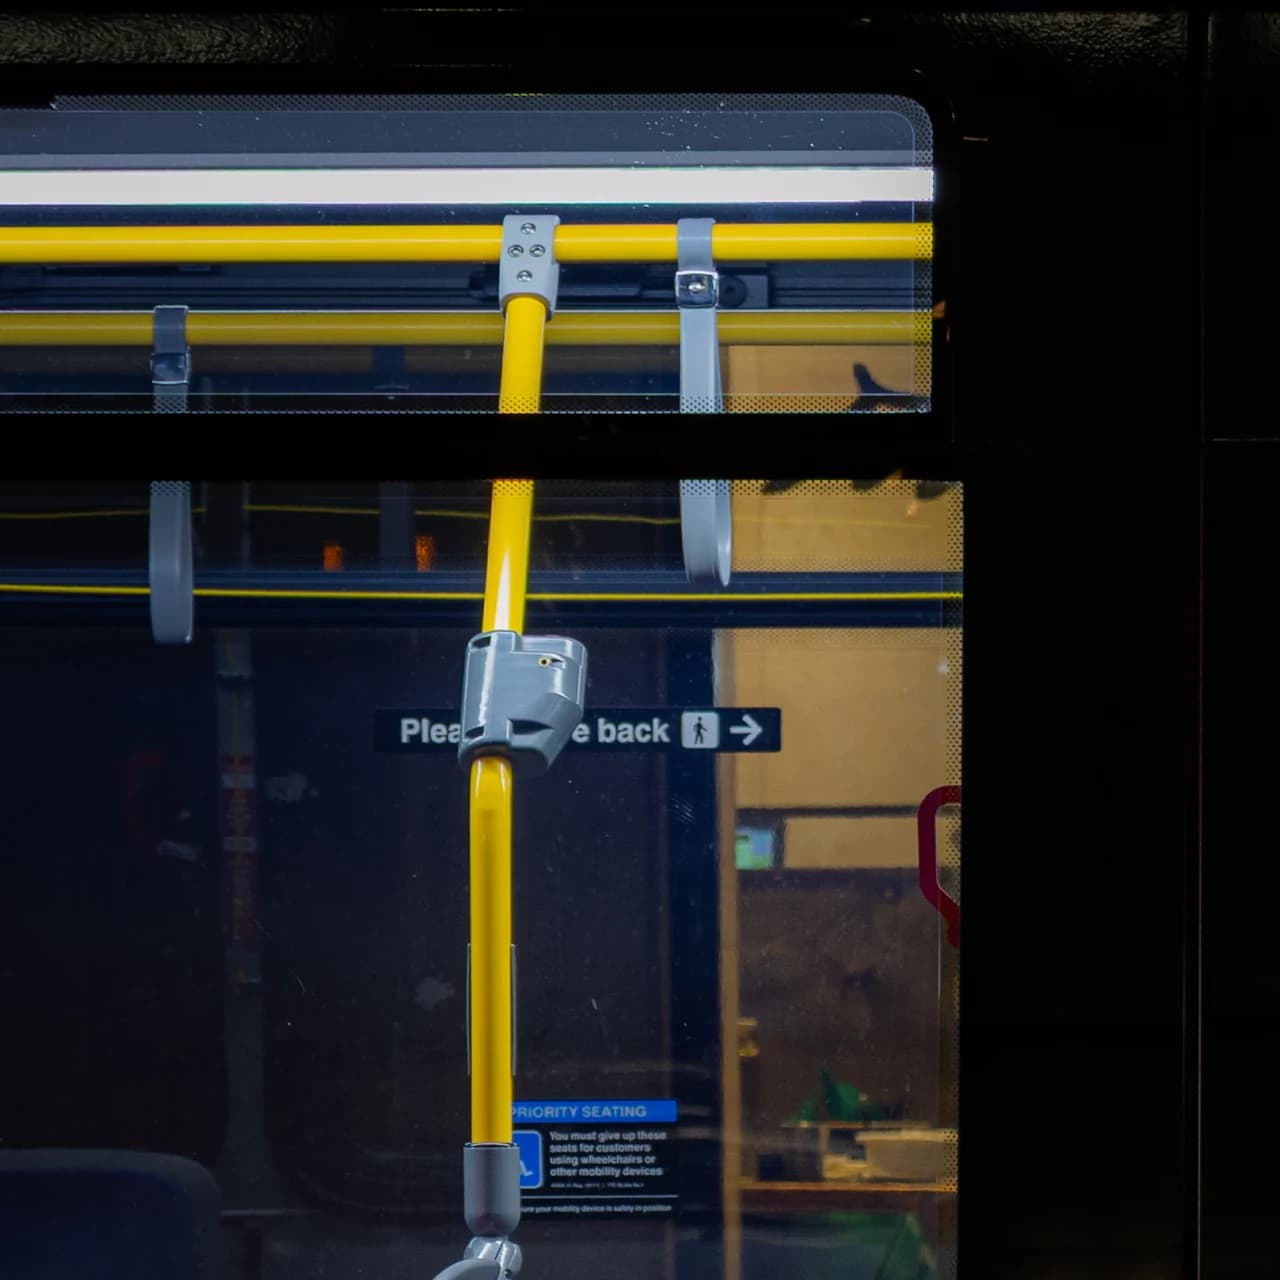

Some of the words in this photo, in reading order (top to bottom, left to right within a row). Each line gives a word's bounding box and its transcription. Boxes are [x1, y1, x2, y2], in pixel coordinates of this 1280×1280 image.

[400, 718, 461, 744] Plea
[598, 717, 671, 744] back
[581, 1105, 648, 1118] SEATING
[550, 1131, 569, 1140] You
[570, 1131, 597, 1140] must
[598, 1131, 620, 1142] give
[622, 1132, 636, 1142] up
[637, 1131, 667, 1140] these
[550, 1144, 578, 1153] seats
[579, 1144, 595, 1153] for
[595, 1144, 652, 1153] customers
[550, 1155, 579, 1167] using
[580, 1155, 643, 1164] wheelchairs
[644, 1156, 657, 1164] or
[550, 1167, 577, 1176] other
[579, 1167, 621, 1178] mobility
[622, 1167, 664, 1176] devices
